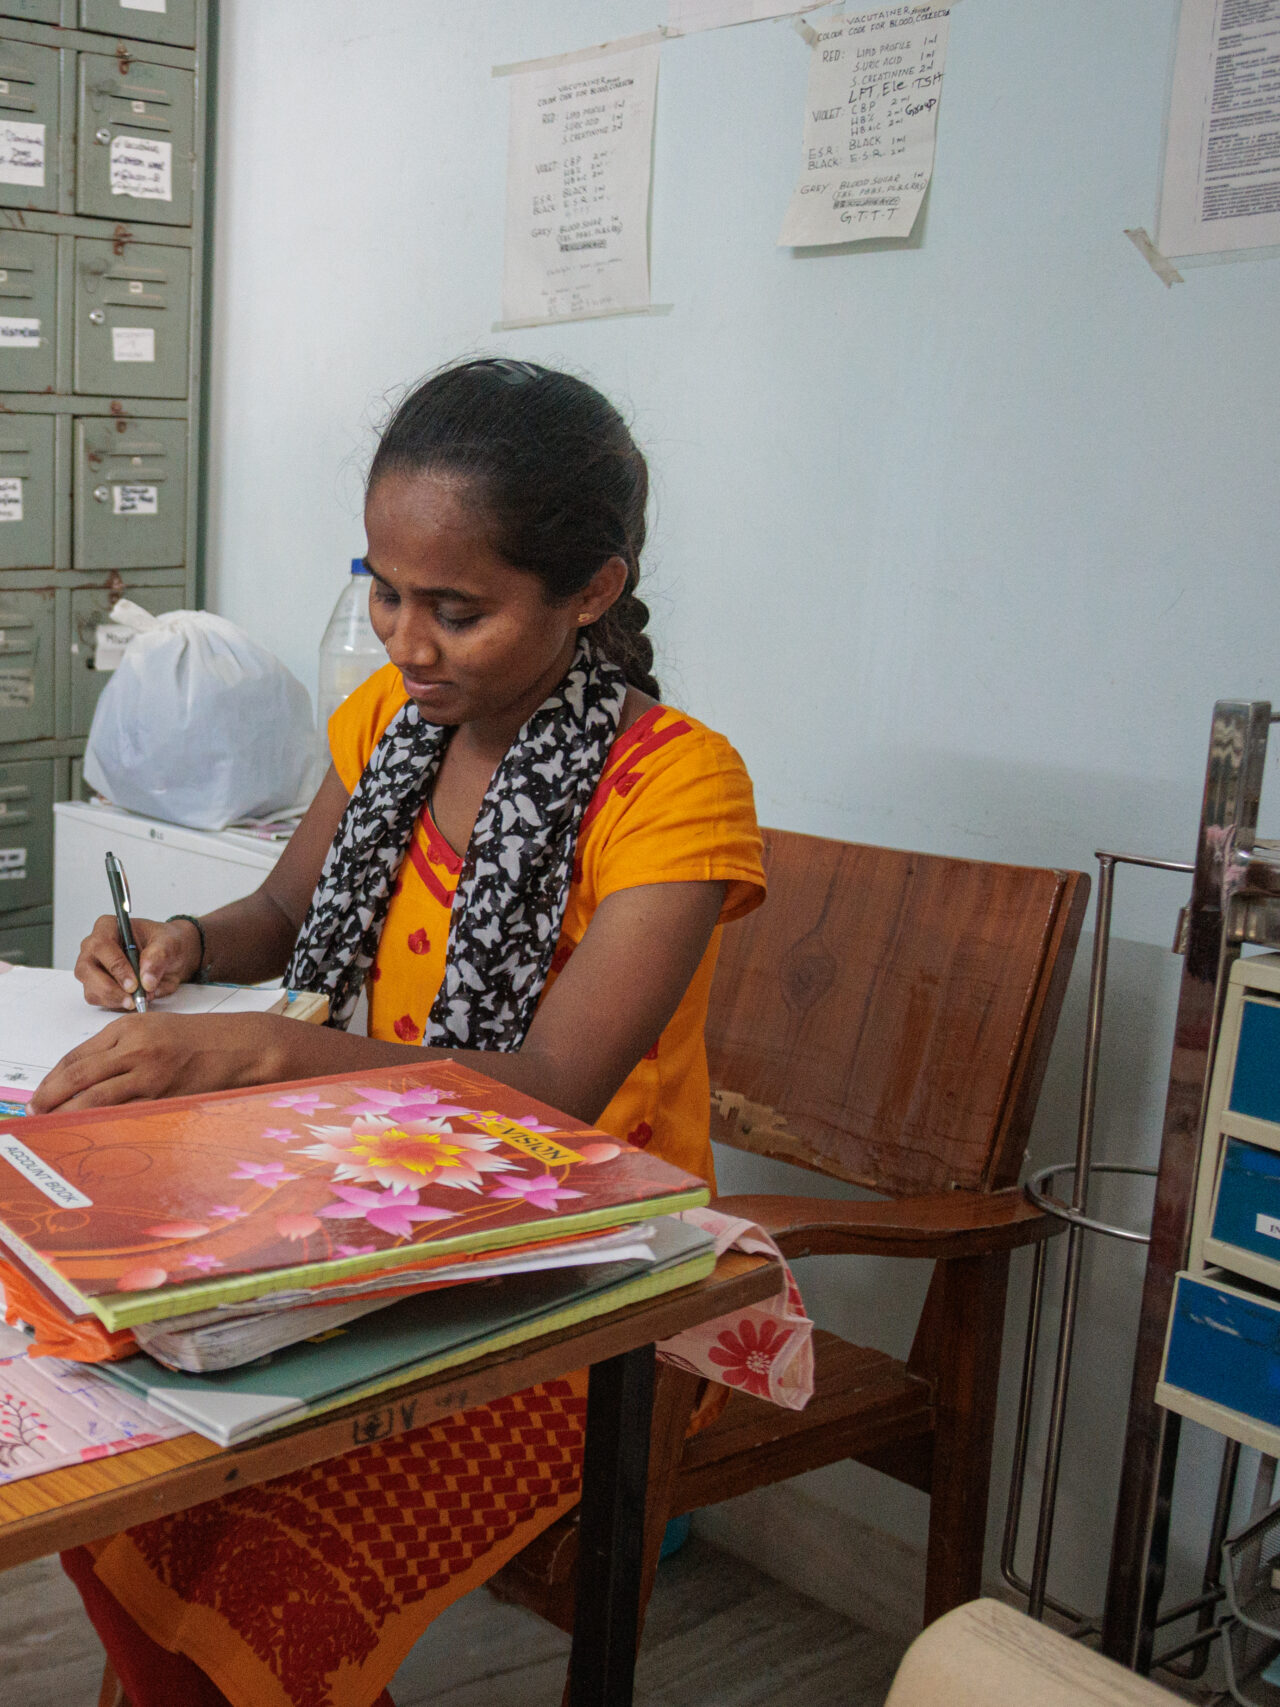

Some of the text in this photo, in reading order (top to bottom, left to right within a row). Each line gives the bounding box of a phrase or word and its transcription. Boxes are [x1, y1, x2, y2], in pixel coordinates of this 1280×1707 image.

[501, 1127, 569, 1160] VISION
[4, 1146, 80, 1203] ACCOUNT BOOK
